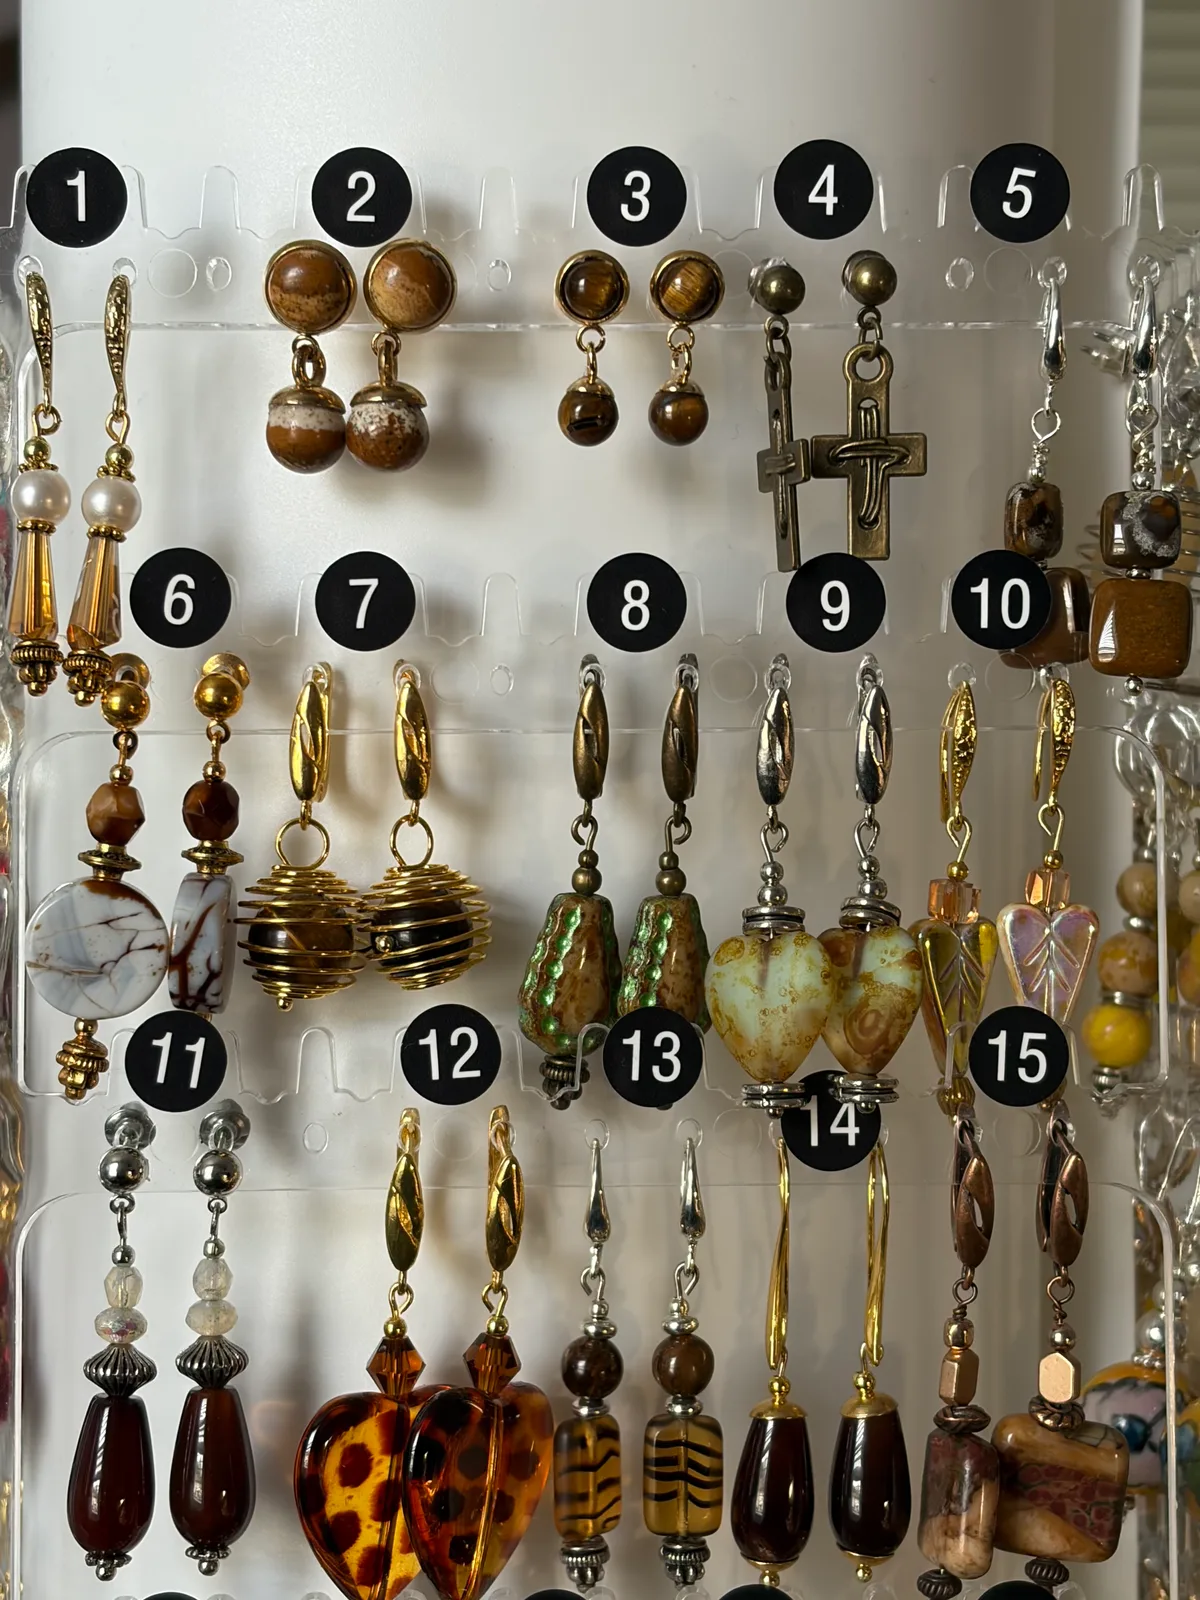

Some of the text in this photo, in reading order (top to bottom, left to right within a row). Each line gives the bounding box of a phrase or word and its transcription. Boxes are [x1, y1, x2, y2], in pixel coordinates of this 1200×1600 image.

[67, 171, 85, 221] 1
[347, 171, 375, 222] 2
[621, 170, 650, 221] 3
[808, 164, 838, 215] 4
[1003, 167, 1036, 218] 5
[164, 574, 195, 625] 6
[349, 578, 378, 628] 7
[621, 580, 649, 630] 8
[821, 580, 850, 631] 9
[971, 578, 1030, 629] 10
[152, 1032, 205, 1088] 11
[419, 1027, 480, 1080] 12
[623, 1030, 680, 1082] 13
[988, 1030, 1047, 1083] 15
[800, 1095, 860, 1147] 14
